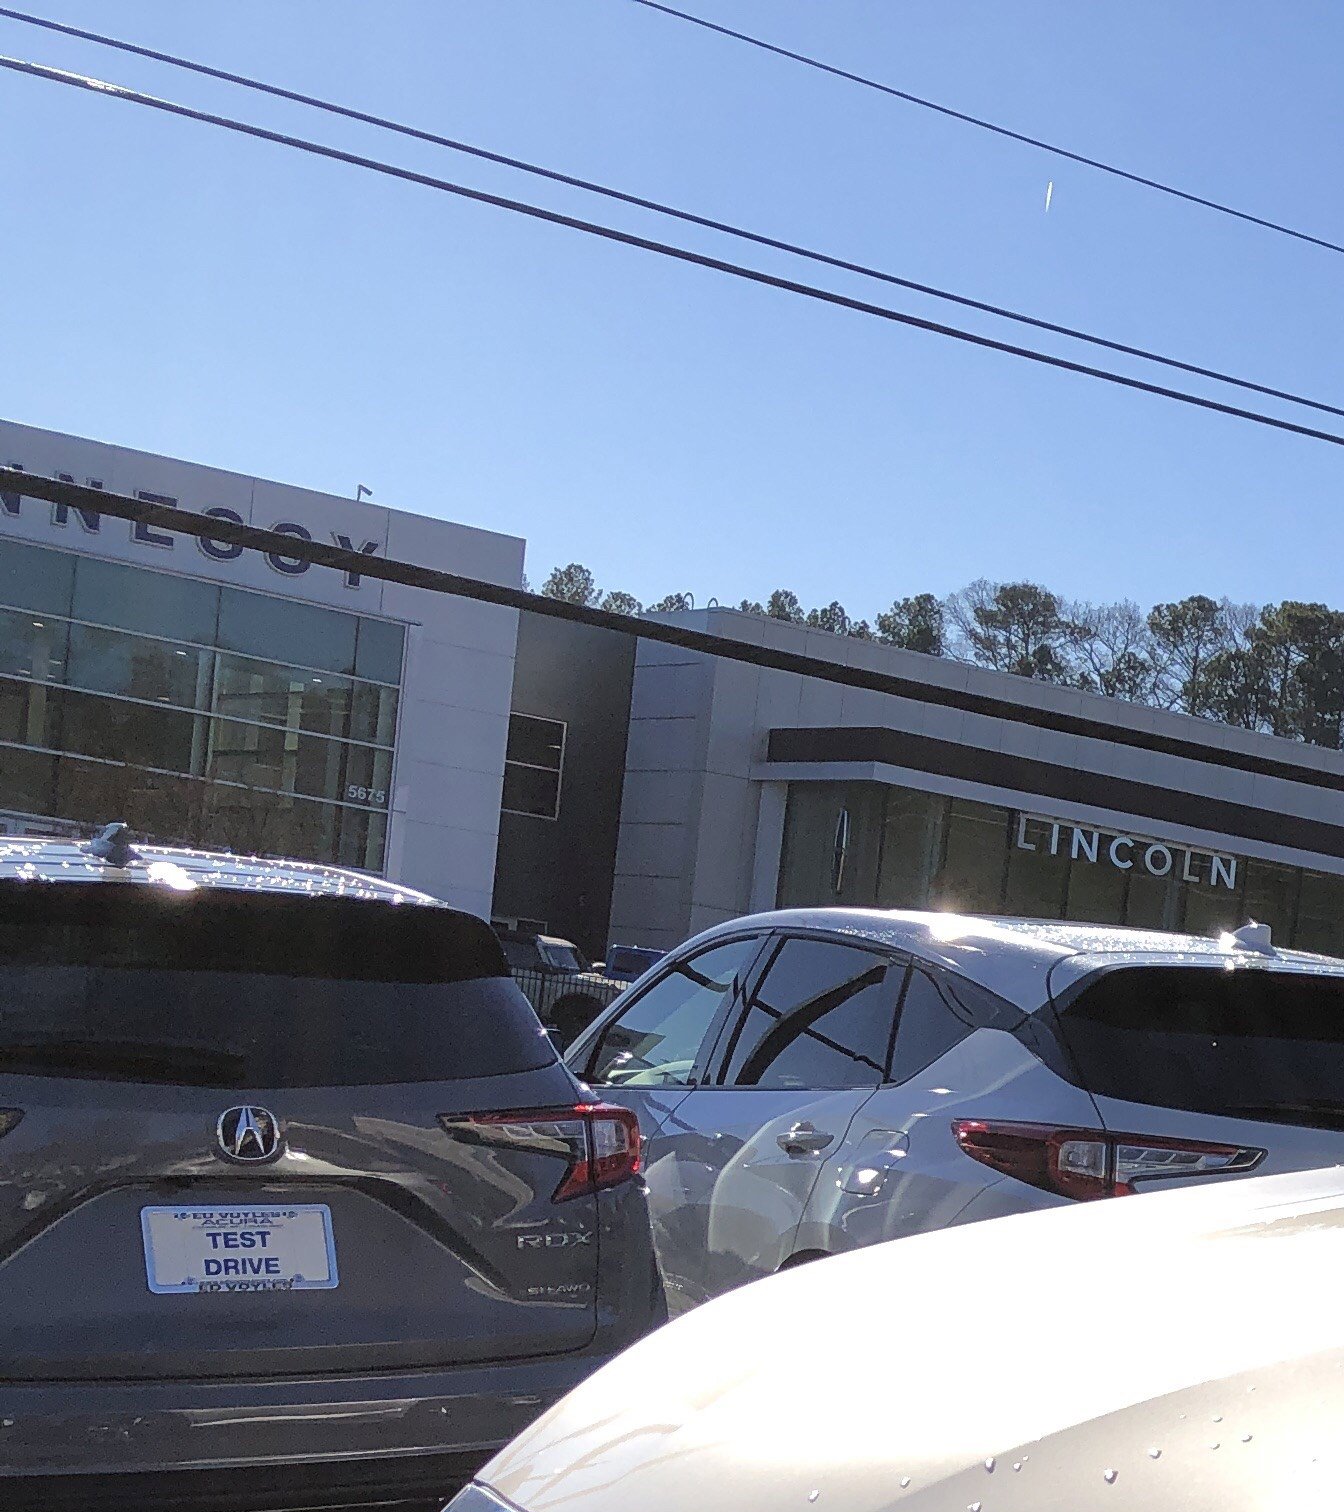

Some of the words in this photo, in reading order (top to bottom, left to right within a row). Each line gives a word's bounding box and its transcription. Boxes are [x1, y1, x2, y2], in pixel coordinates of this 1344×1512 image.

[348, 784, 386, 803] 5675
[1017, 811, 1237, 890] LINCOLN
[205, 1230, 271, 1250] TEST
[517, 1231, 593, 1249] RDX
[204, 1257, 281, 1276] DRIVE
